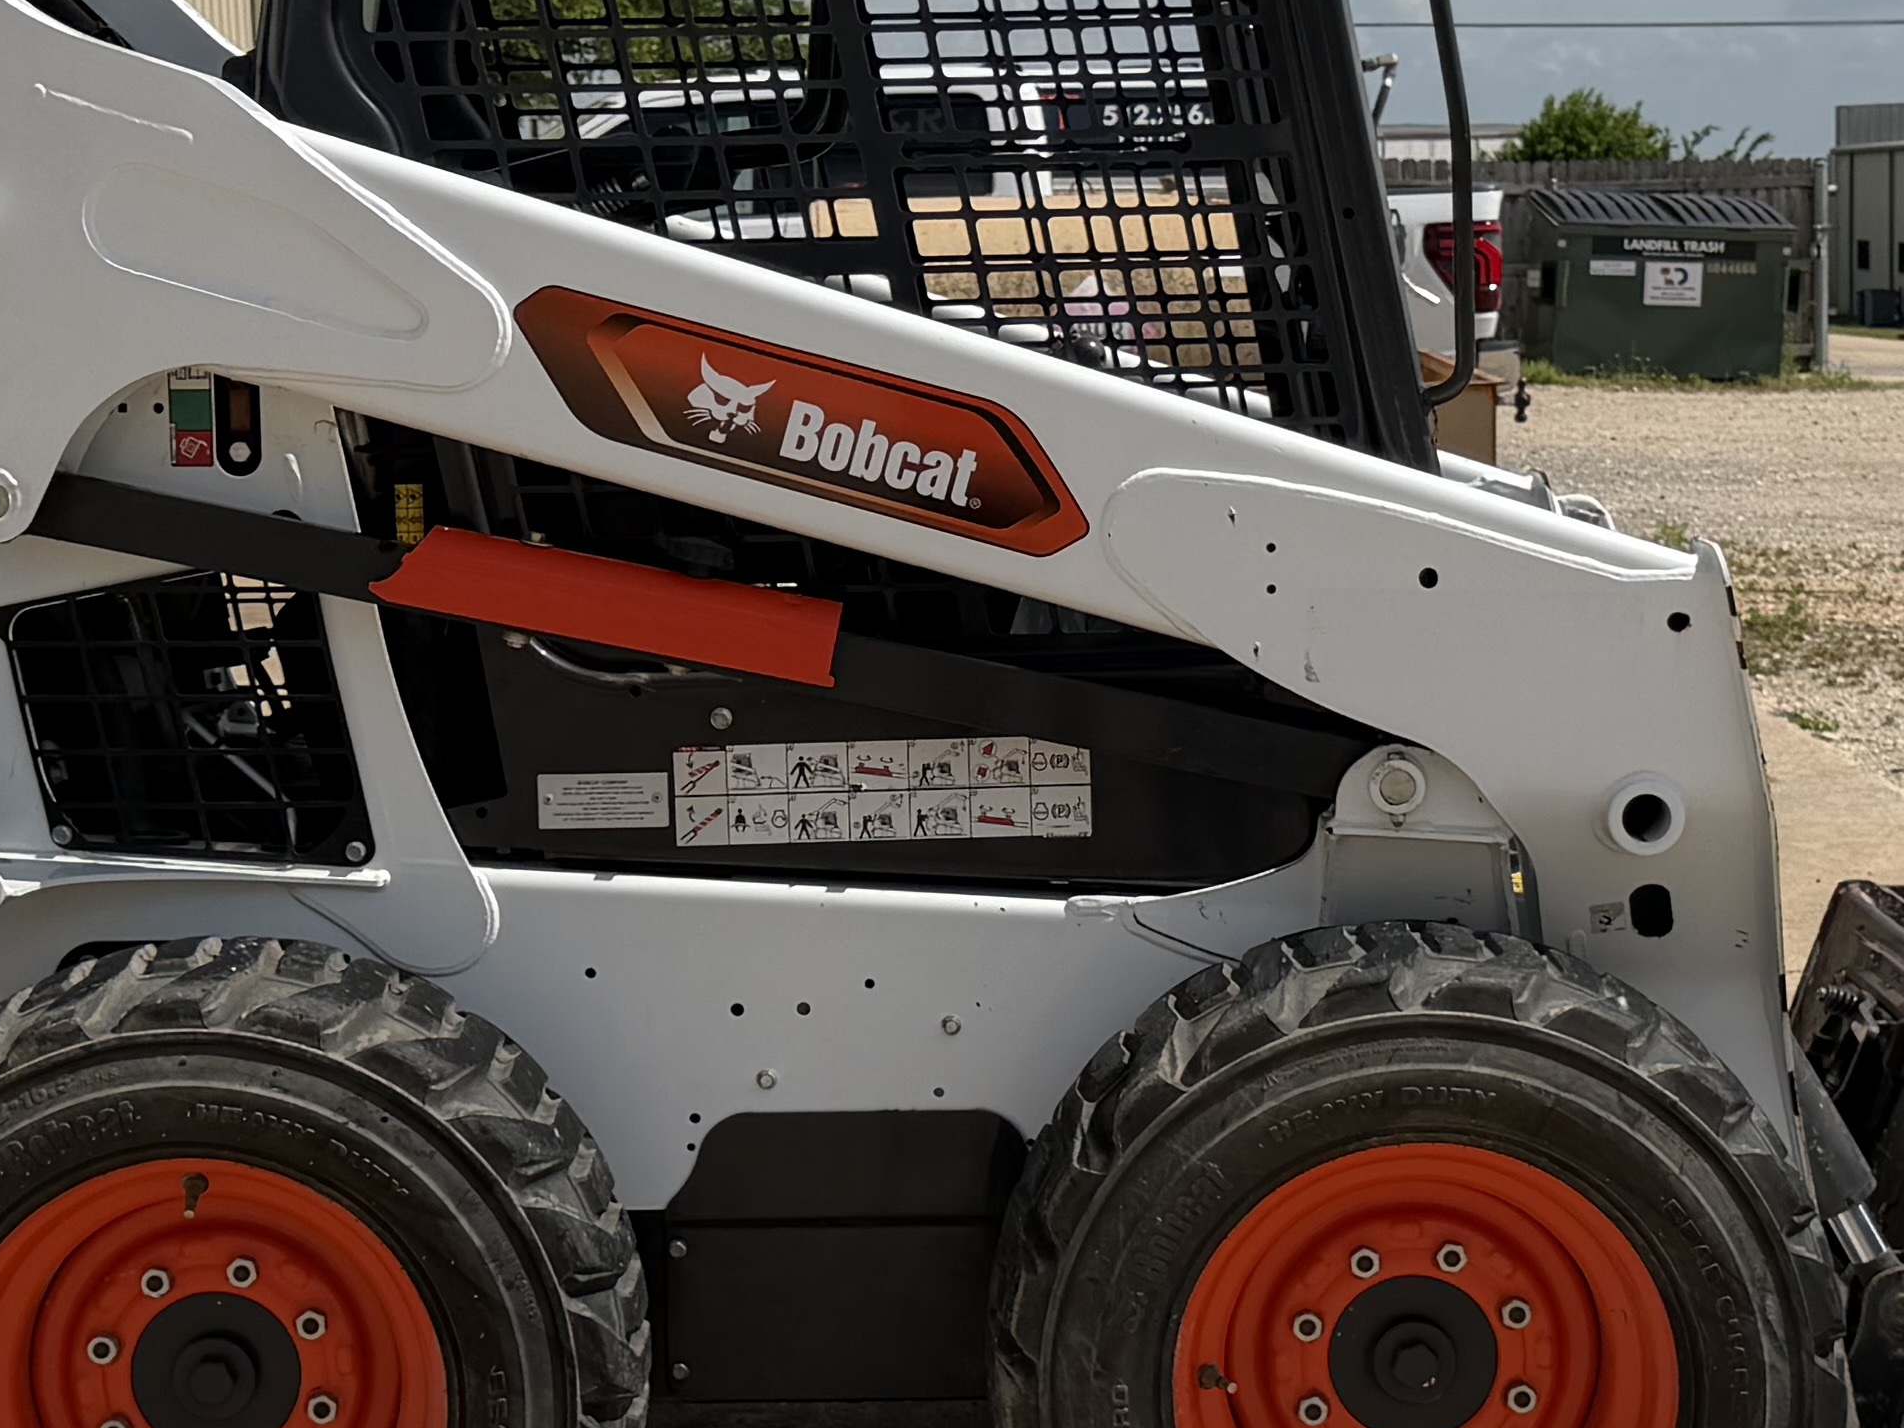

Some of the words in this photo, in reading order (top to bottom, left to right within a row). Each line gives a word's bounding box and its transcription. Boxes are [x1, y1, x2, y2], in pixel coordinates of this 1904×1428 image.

[1623, 238, 1680, 252] LANDFILL
[1683, 240, 1726, 254] TRASH
[779, 399, 978, 508] Bobcat
